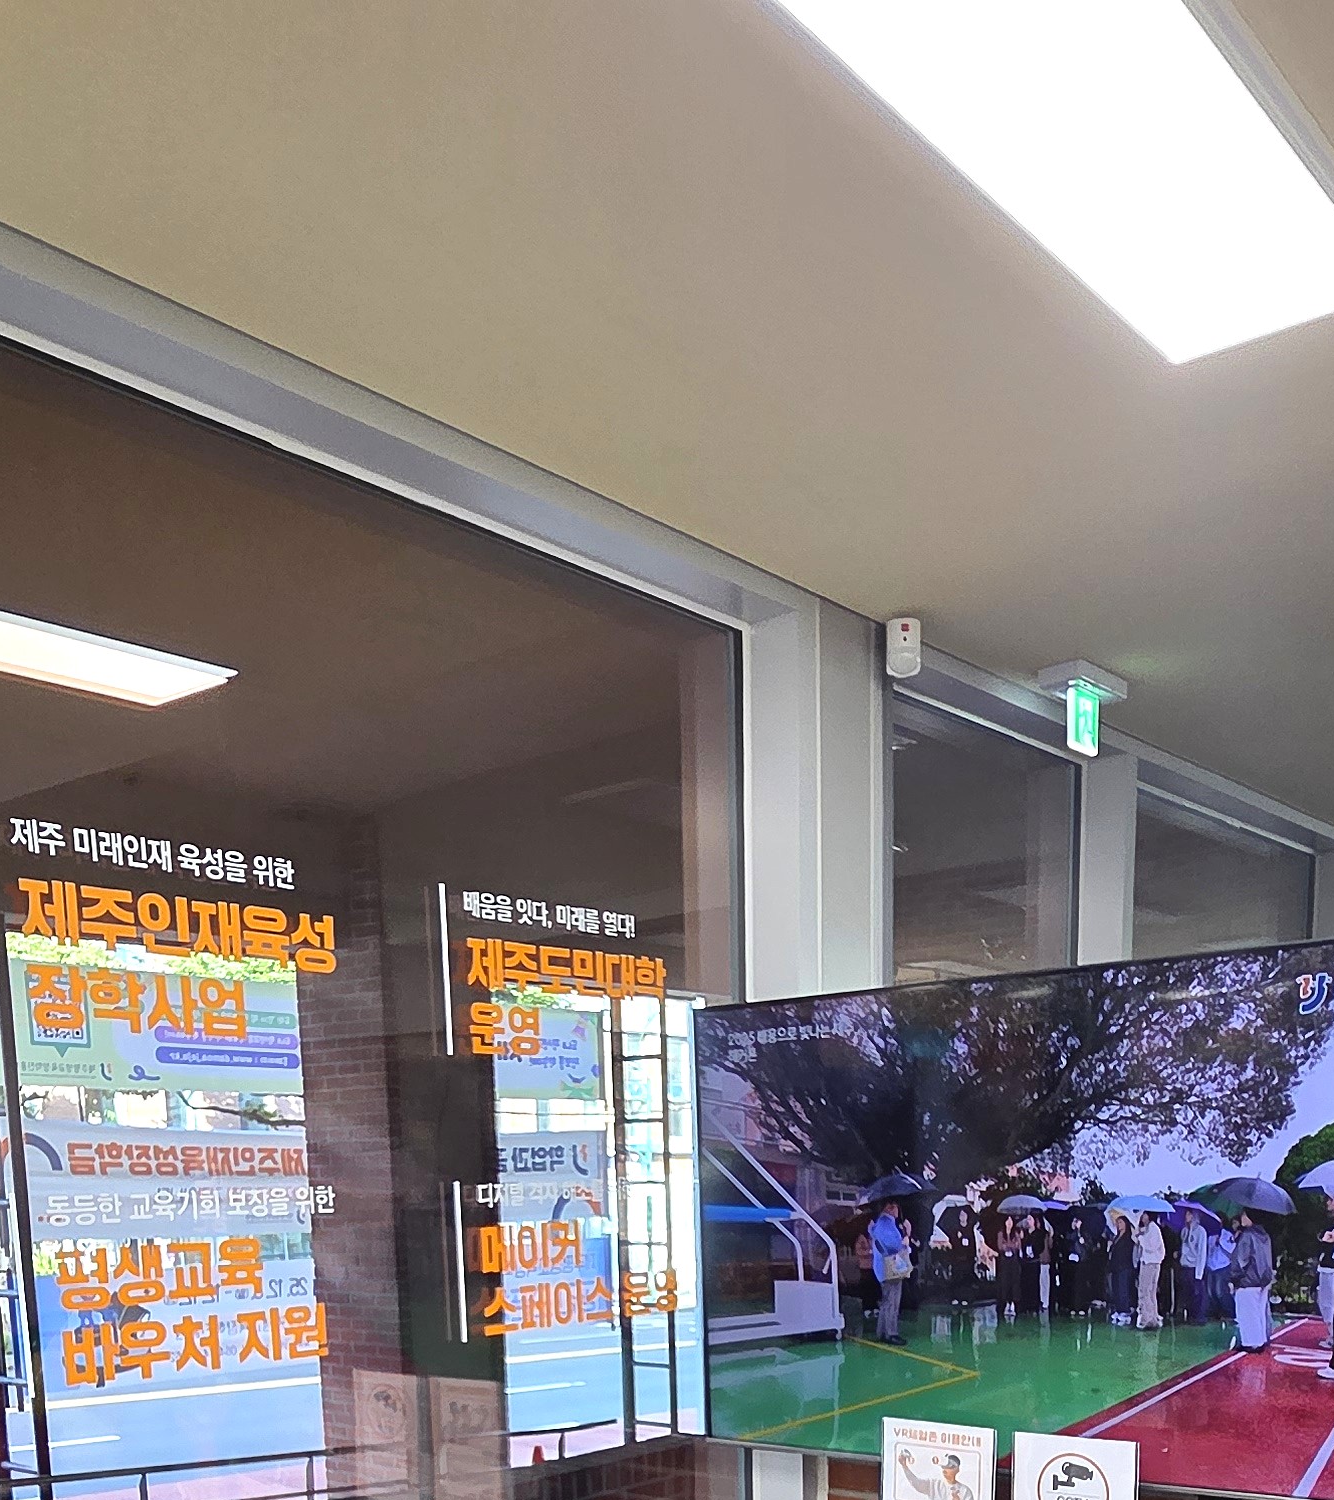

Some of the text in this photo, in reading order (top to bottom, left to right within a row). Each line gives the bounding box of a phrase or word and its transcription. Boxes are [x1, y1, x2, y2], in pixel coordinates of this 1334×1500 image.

[10, 817, 295, 890] 제주 미래인재 육성을 위한
[17, 877, 338, 975] 제주인재육성
[462, 890, 636, 939] 배움을 잇다, 미래를 열다!
[466, 937, 667, 1000] 제주도민대학
[25, 963, 249, 1041] 장학사업
[469, 1001, 543, 1056] 운영
[46, 1194, 122, 1227] 동등한
[129, 1187, 220, 1223] 교육기회
[227, 1185, 290, 1218] 보장을
[295, 1184, 336, 1216] 위한
[55, 1237, 265, 1311] 평생교육
[480, 1219, 582, 1274] 메이커
[483, 1276, 615, 1337] 스페이스
[62, 1314, 220, 1387] 바우처
[235, 1301, 329, 1364] 지원
